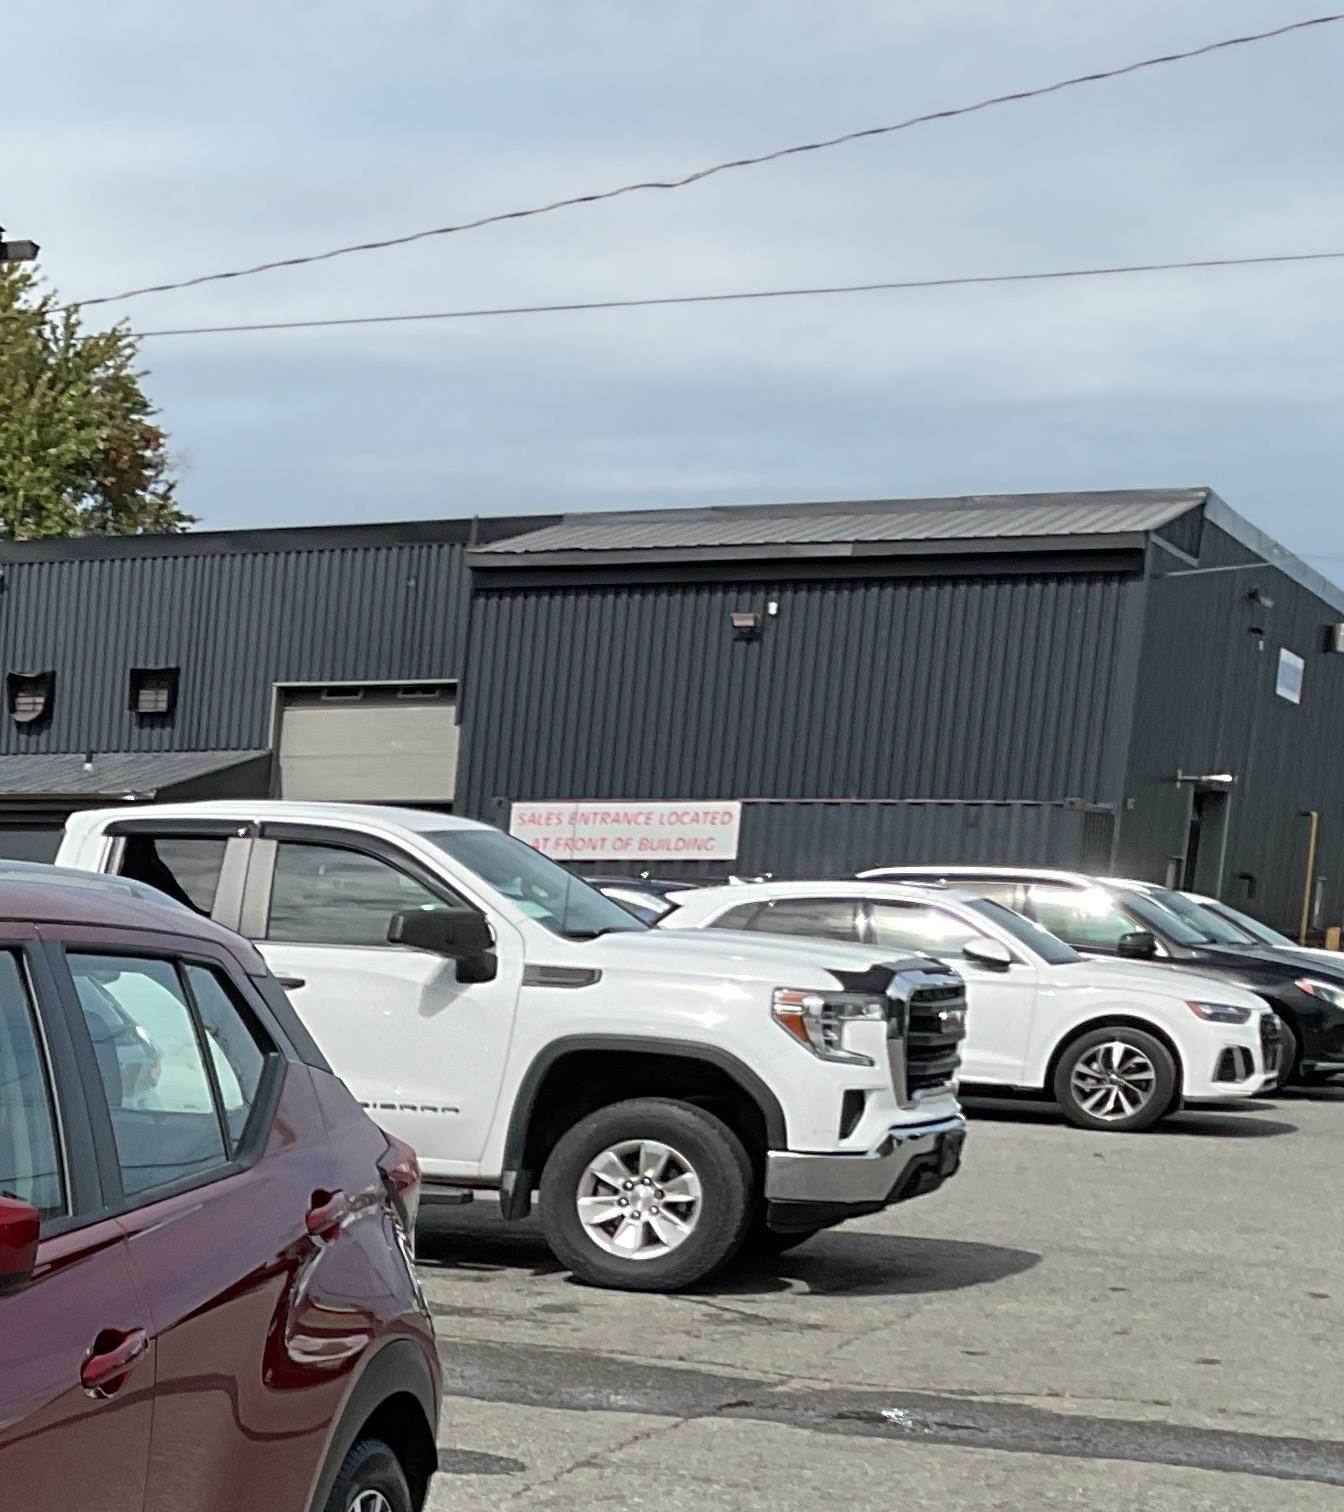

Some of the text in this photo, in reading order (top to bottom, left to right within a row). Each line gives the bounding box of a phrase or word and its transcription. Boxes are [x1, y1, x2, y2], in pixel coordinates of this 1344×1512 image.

[518, 811, 733, 827] SALES ENTRANCE LOCATED
[531, 837, 717, 852] AT FRONT OF BUILDING
